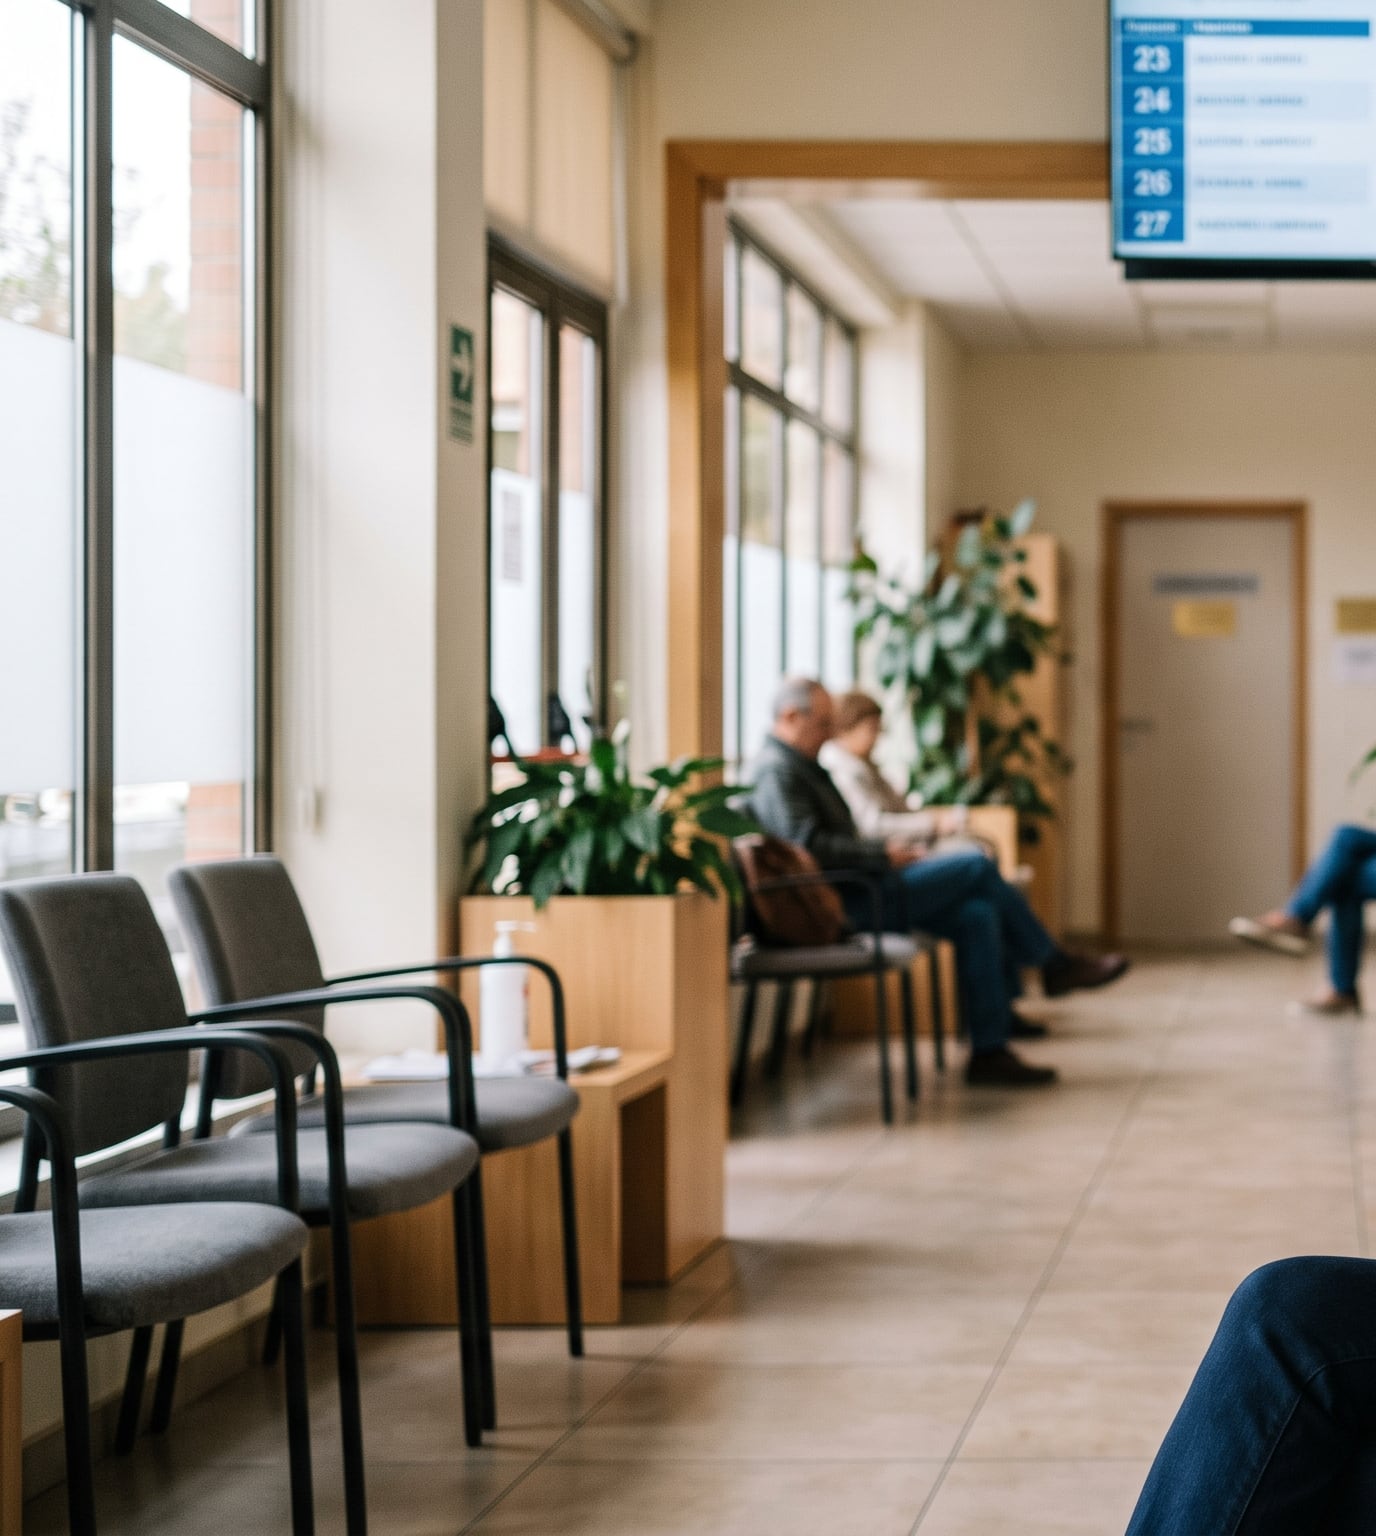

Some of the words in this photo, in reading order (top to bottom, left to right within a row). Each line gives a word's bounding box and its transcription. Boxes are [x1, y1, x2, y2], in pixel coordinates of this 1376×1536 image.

[1134, 45, 1171, 72] 23
[1134, 87, 1171, 113] 24
[1134, 128, 1172, 155] 25
[1134, 169, 1172, 196] 26
[1134, 210, 1171, 237] 27
